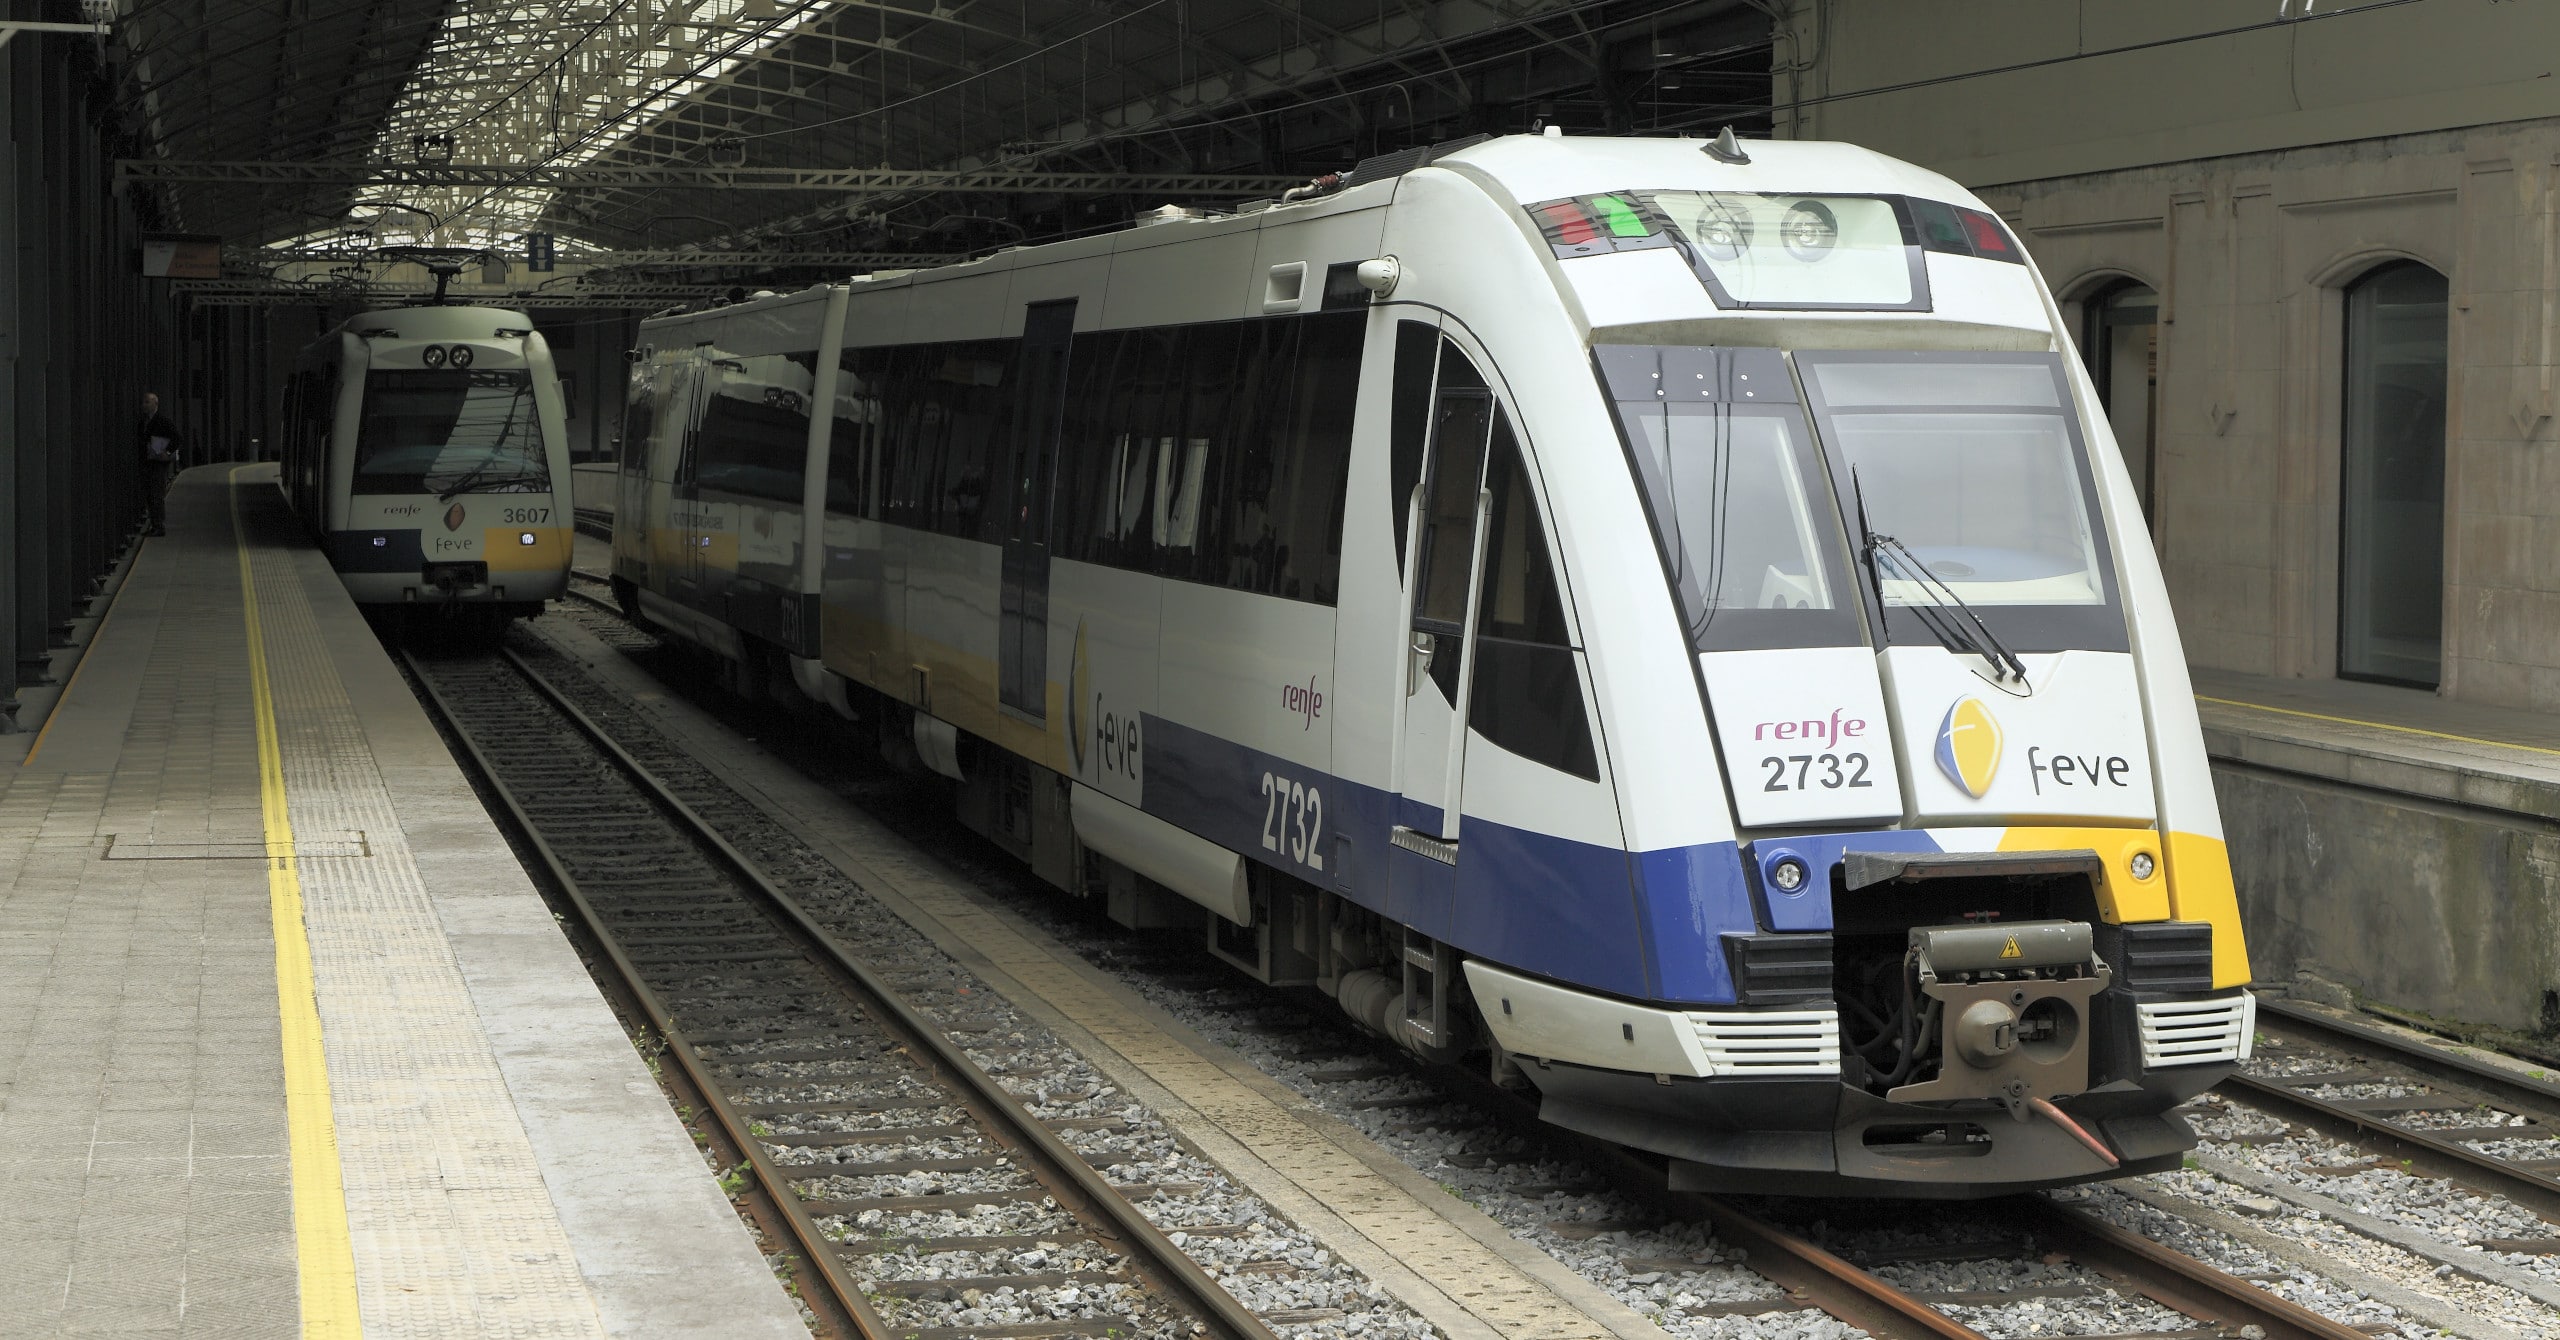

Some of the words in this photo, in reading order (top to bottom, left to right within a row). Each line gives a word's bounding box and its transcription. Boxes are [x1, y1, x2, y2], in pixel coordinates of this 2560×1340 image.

[383, 503, 422, 516] renfe
[503, 508, 550, 524] 3607
[436, 537, 473, 553] feve
[1282, 675, 1323, 732] renfe
[1096, 691, 1138, 785] feve
[1754, 707, 1867, 750] renfe
[1760, 752, 1873, 793] 2732
[2027, 746, 2130, 796] feve
[1261, 771, 1323, 872] 2732
